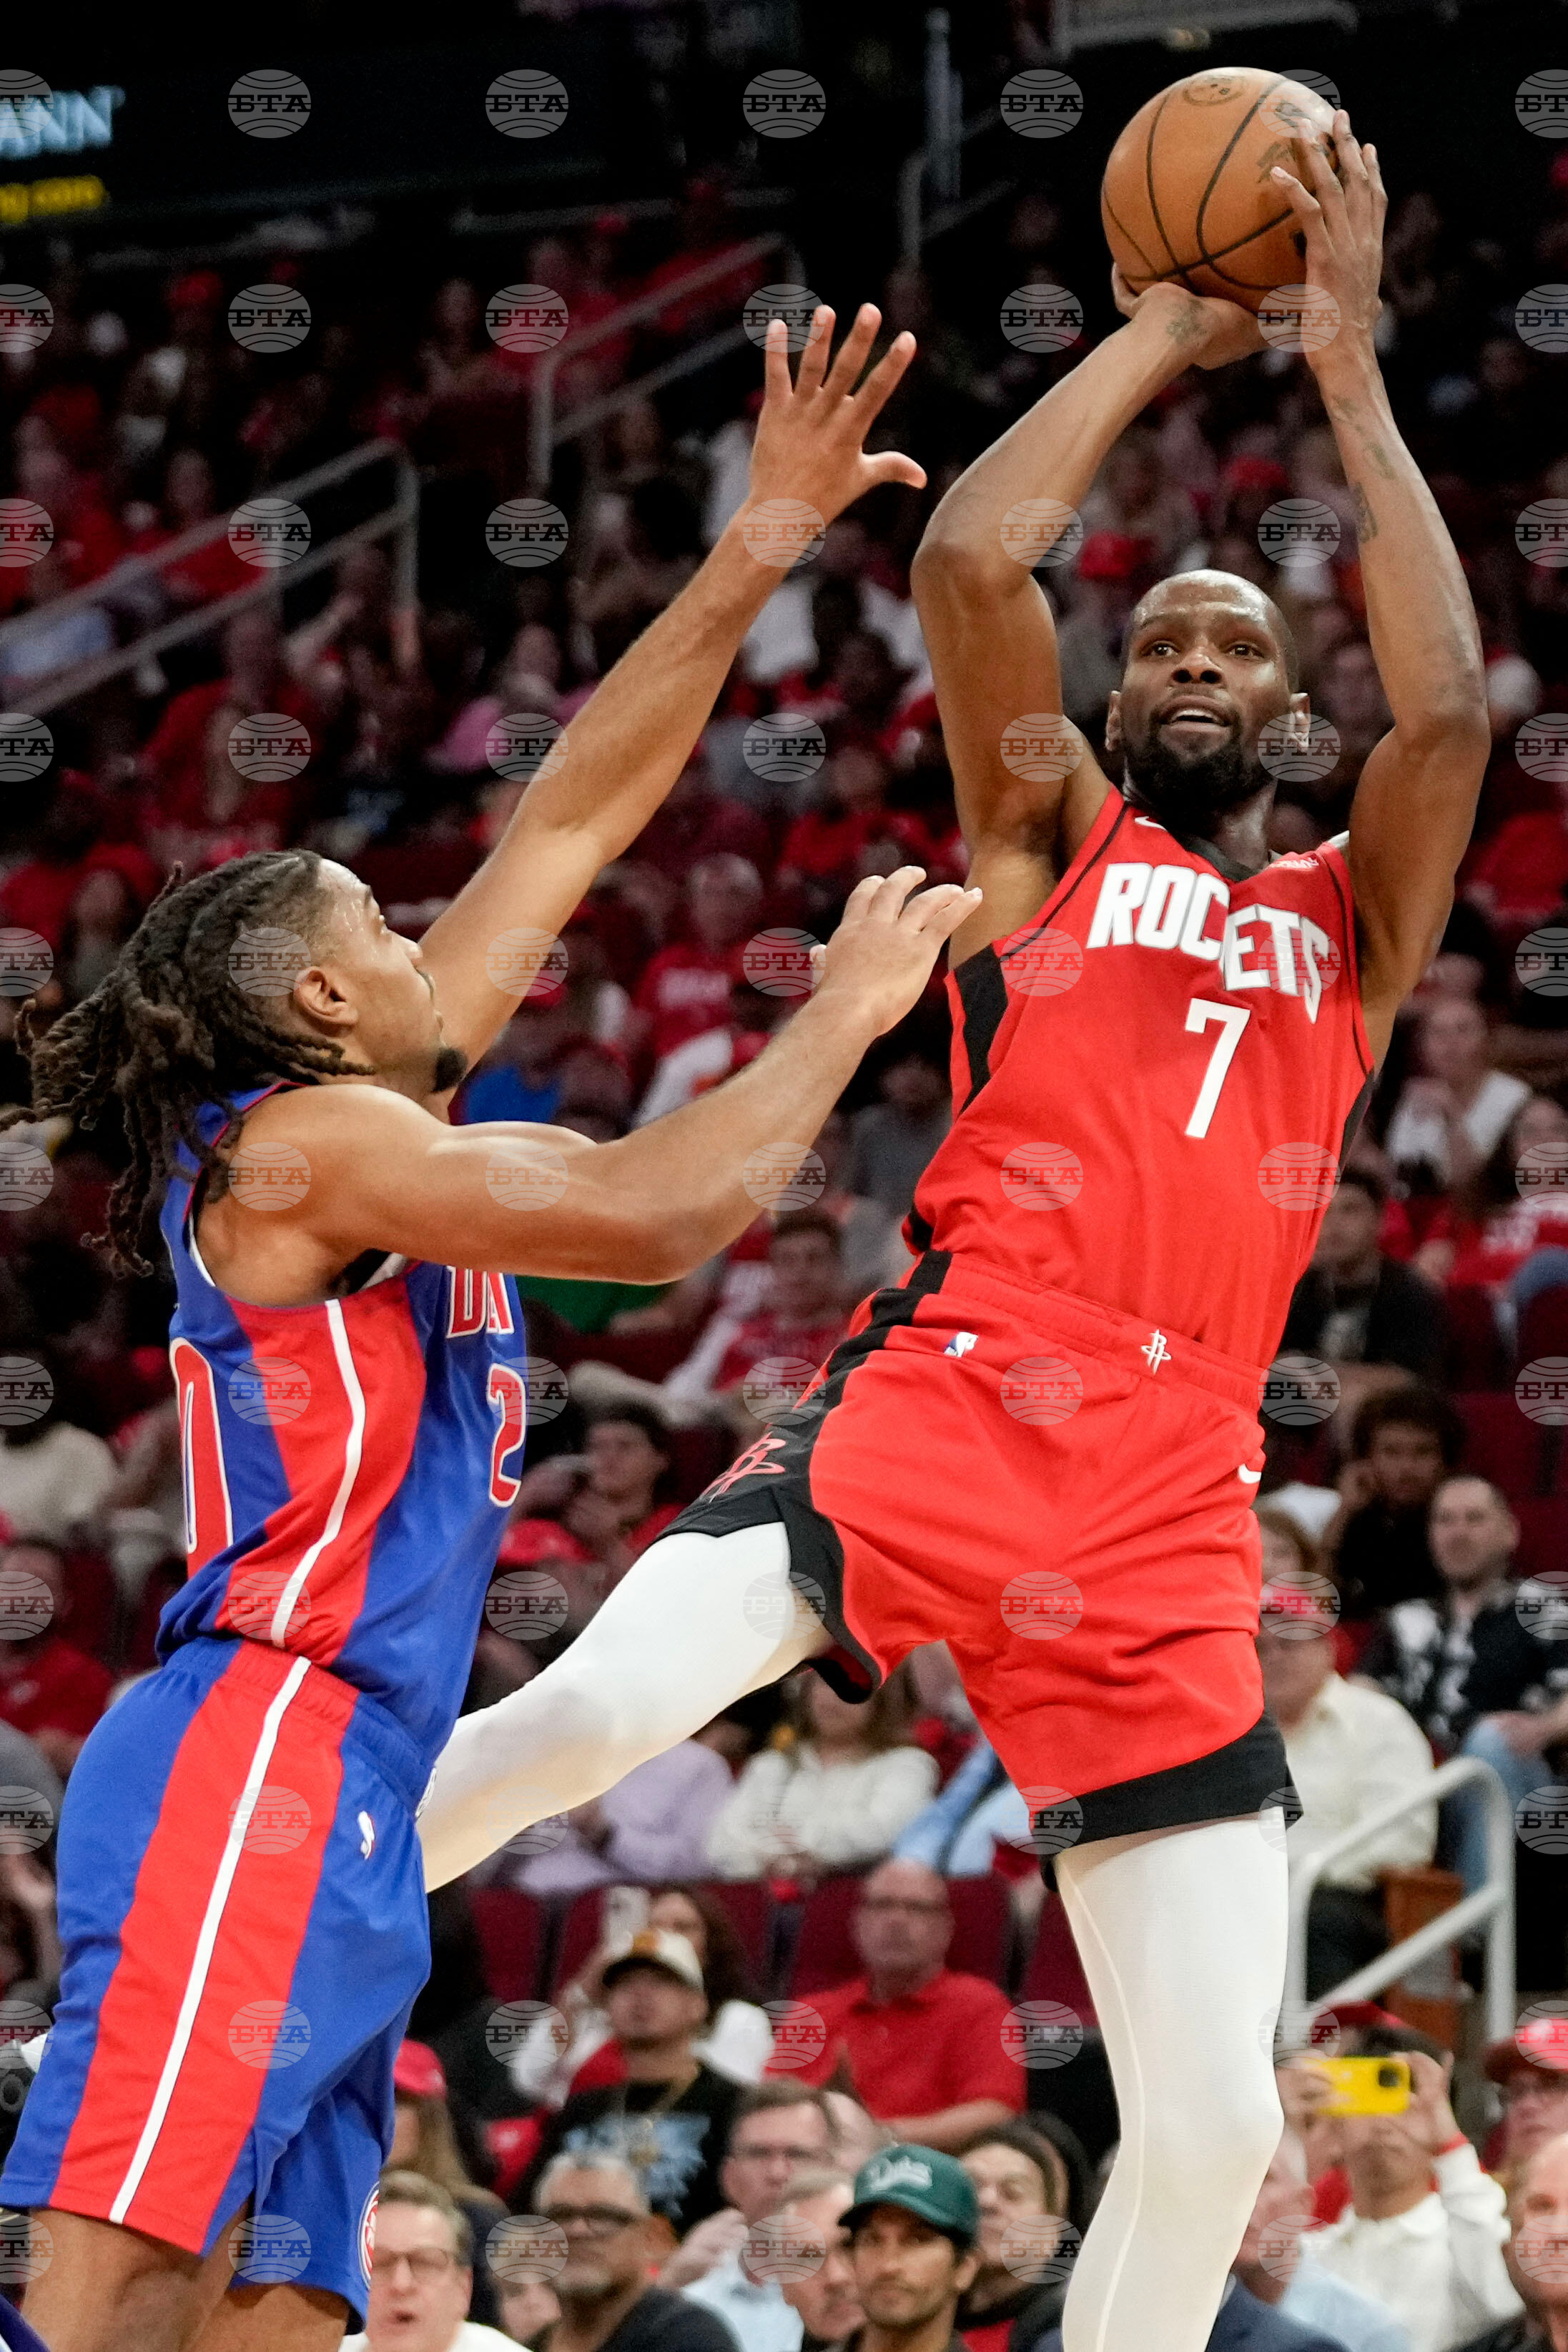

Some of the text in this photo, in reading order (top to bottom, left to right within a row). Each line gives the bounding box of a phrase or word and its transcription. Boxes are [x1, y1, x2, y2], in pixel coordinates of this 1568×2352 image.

[1086, 862, 1330, 1025] ROCETS
[1184, 998, 1251, 1138] 7
[488, 1363, 526, 1507] 2
